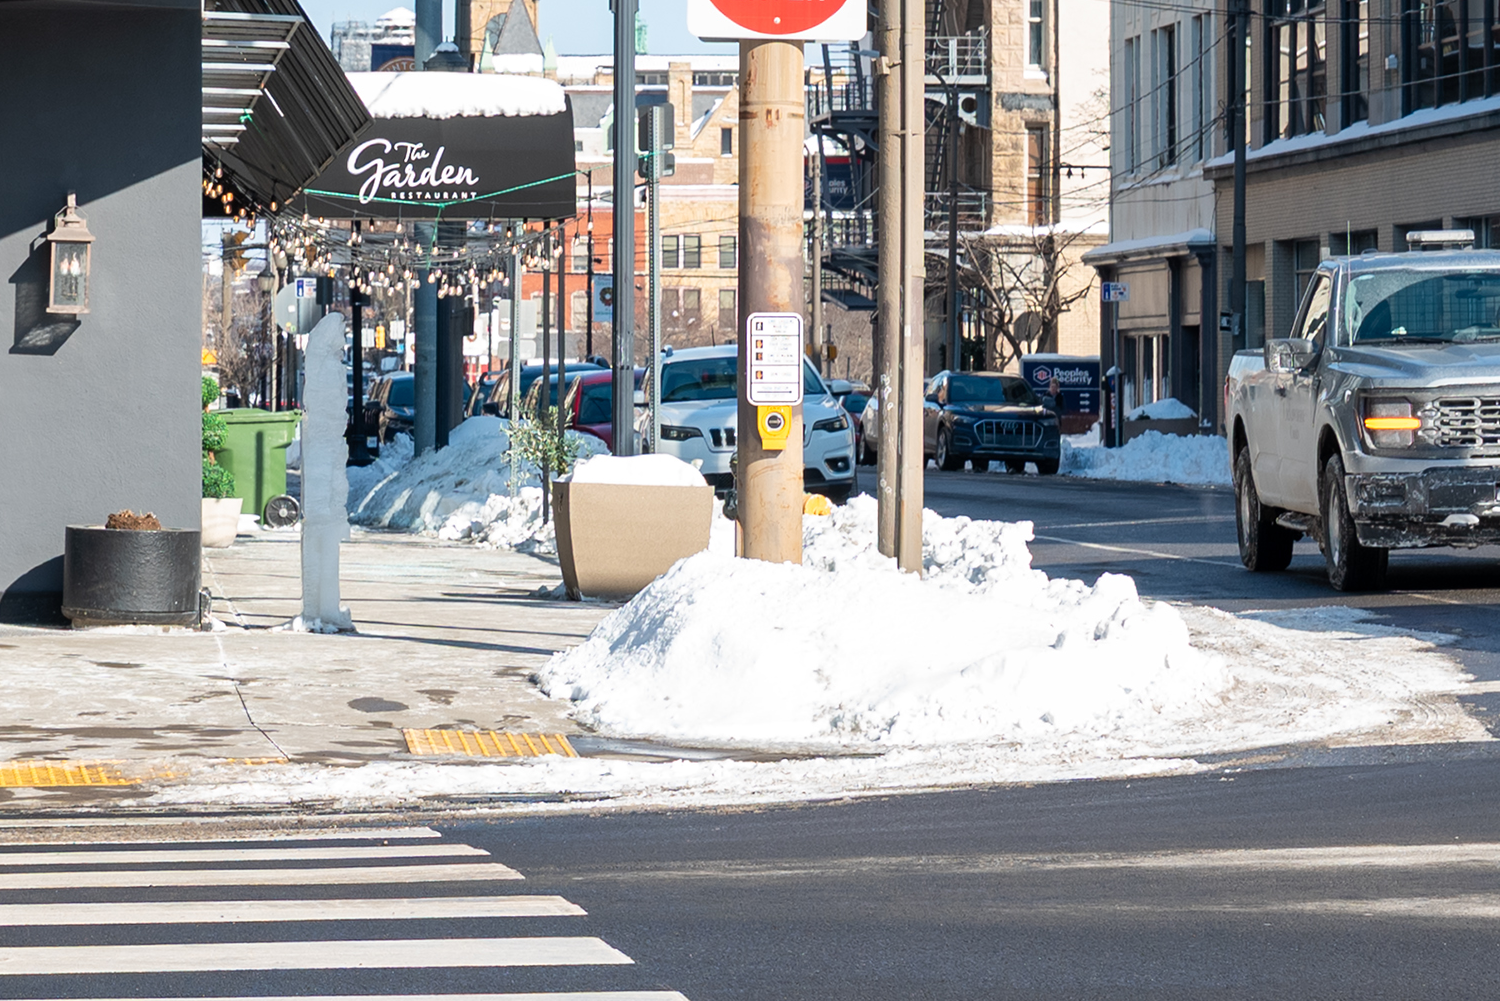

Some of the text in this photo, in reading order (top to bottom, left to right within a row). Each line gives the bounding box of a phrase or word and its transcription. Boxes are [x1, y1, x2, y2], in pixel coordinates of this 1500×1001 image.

[394, 141, 430, 163] The
[347, 137, 480, 205] Garden
[390, 191, 477, 200] RESTAURANT
[1053, 367, 1090, 378] Peoples
